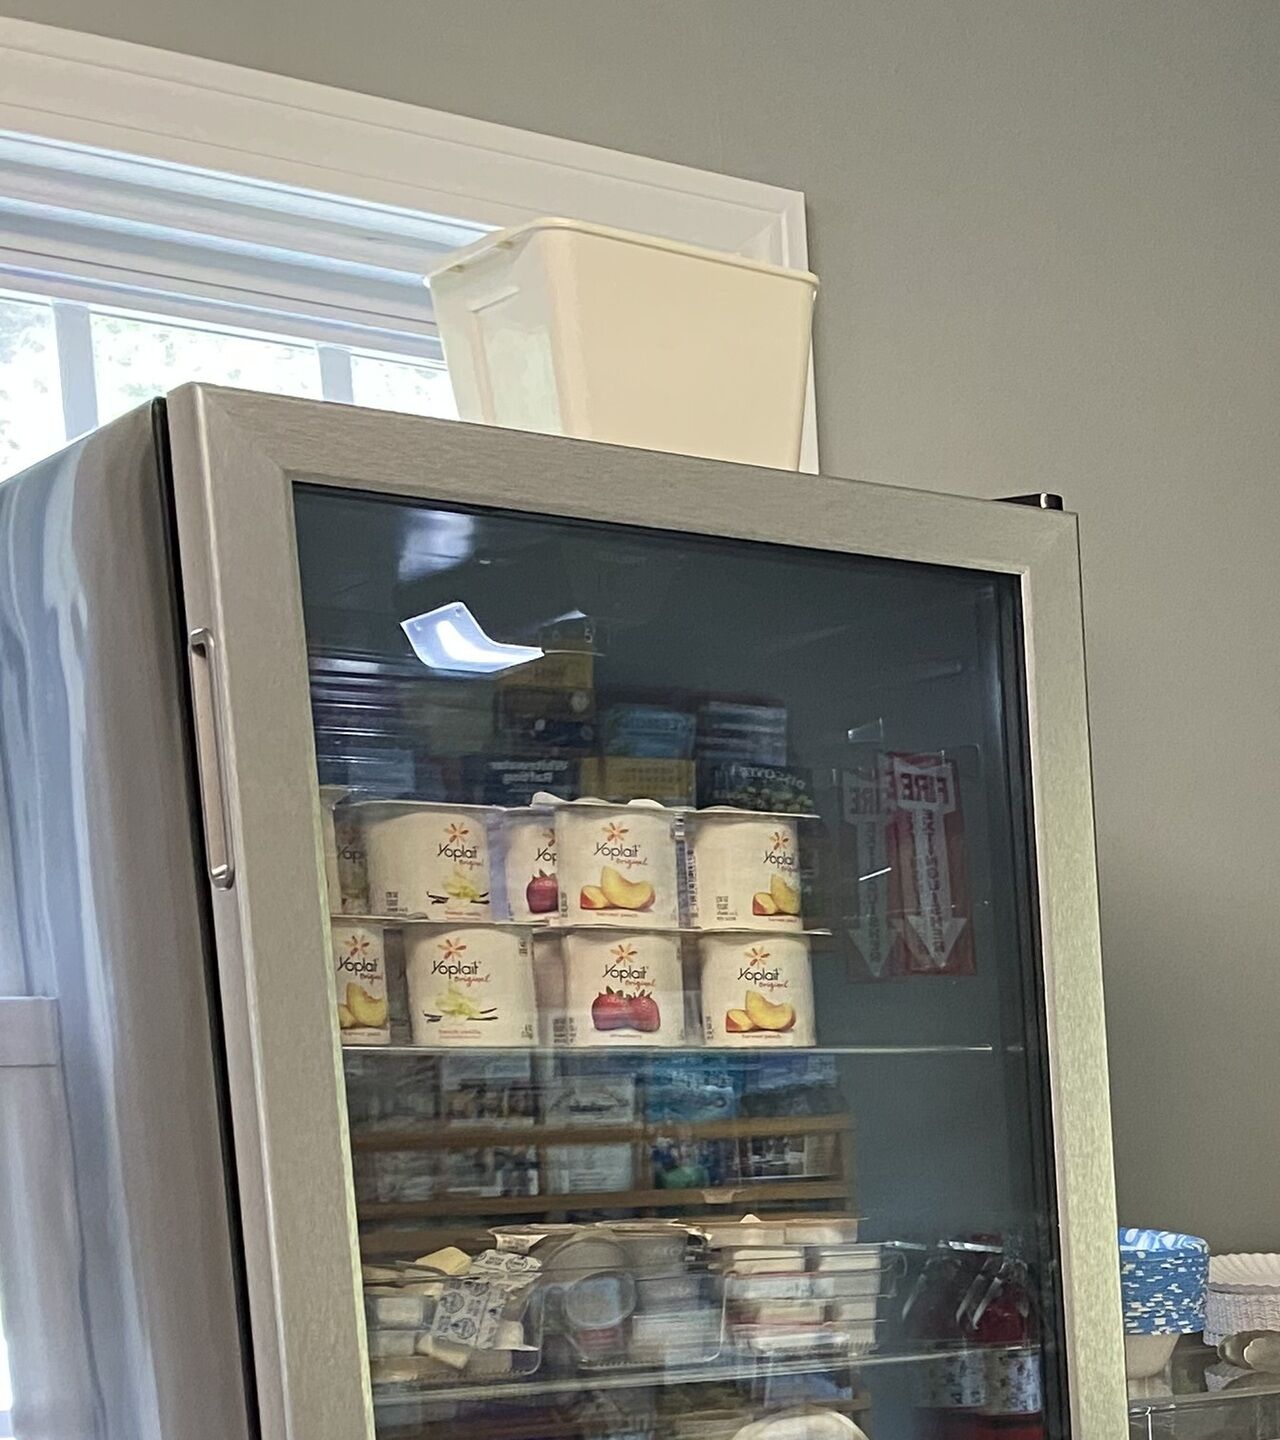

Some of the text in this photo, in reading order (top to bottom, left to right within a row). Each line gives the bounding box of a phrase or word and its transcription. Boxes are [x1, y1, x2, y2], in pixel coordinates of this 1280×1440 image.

[437, 843, 479, 862] Yoplait
[593, 842, 640, 864] Yoplait
[337, 956, 380, 977] Yoplait
[431, 959, 480, 979] Yoplait
[602, 963, 649, 982] Yoplait
[737, 966, 782, 985] Yoplait
